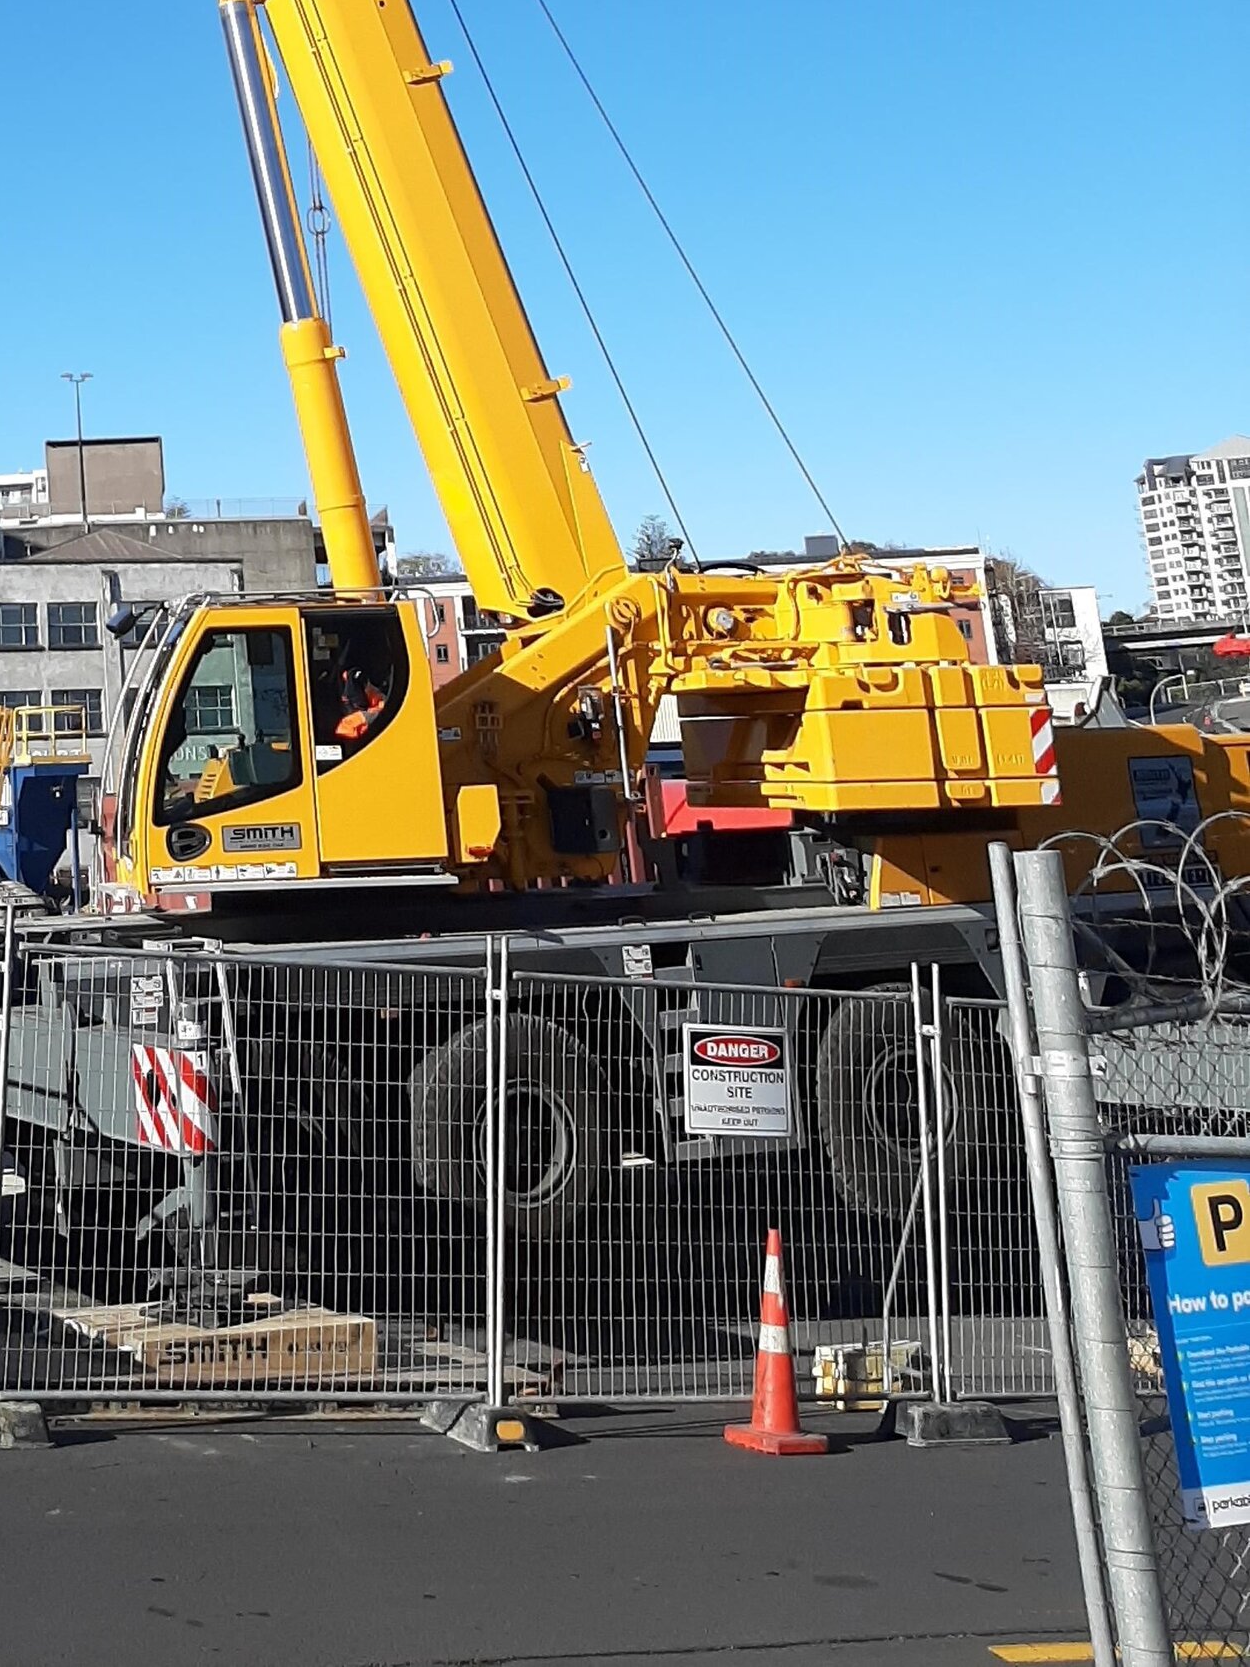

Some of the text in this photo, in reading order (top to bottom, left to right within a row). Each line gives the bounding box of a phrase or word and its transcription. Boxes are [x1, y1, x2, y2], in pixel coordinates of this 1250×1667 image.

[230, 827, 293, 839] SMITH
[707, 1042, 769, 1059] DANGER
[197, 1053, 204, 1067] 1
[692, 1069, 784, 1084] CONSTRUCTION
[727, 1086, 753, 1099] SITE
[1207, 1194, 1243, 1252] P
[1166, 1293, 1206, 1315] How
[1210, 1290, 1229, 1309] to
